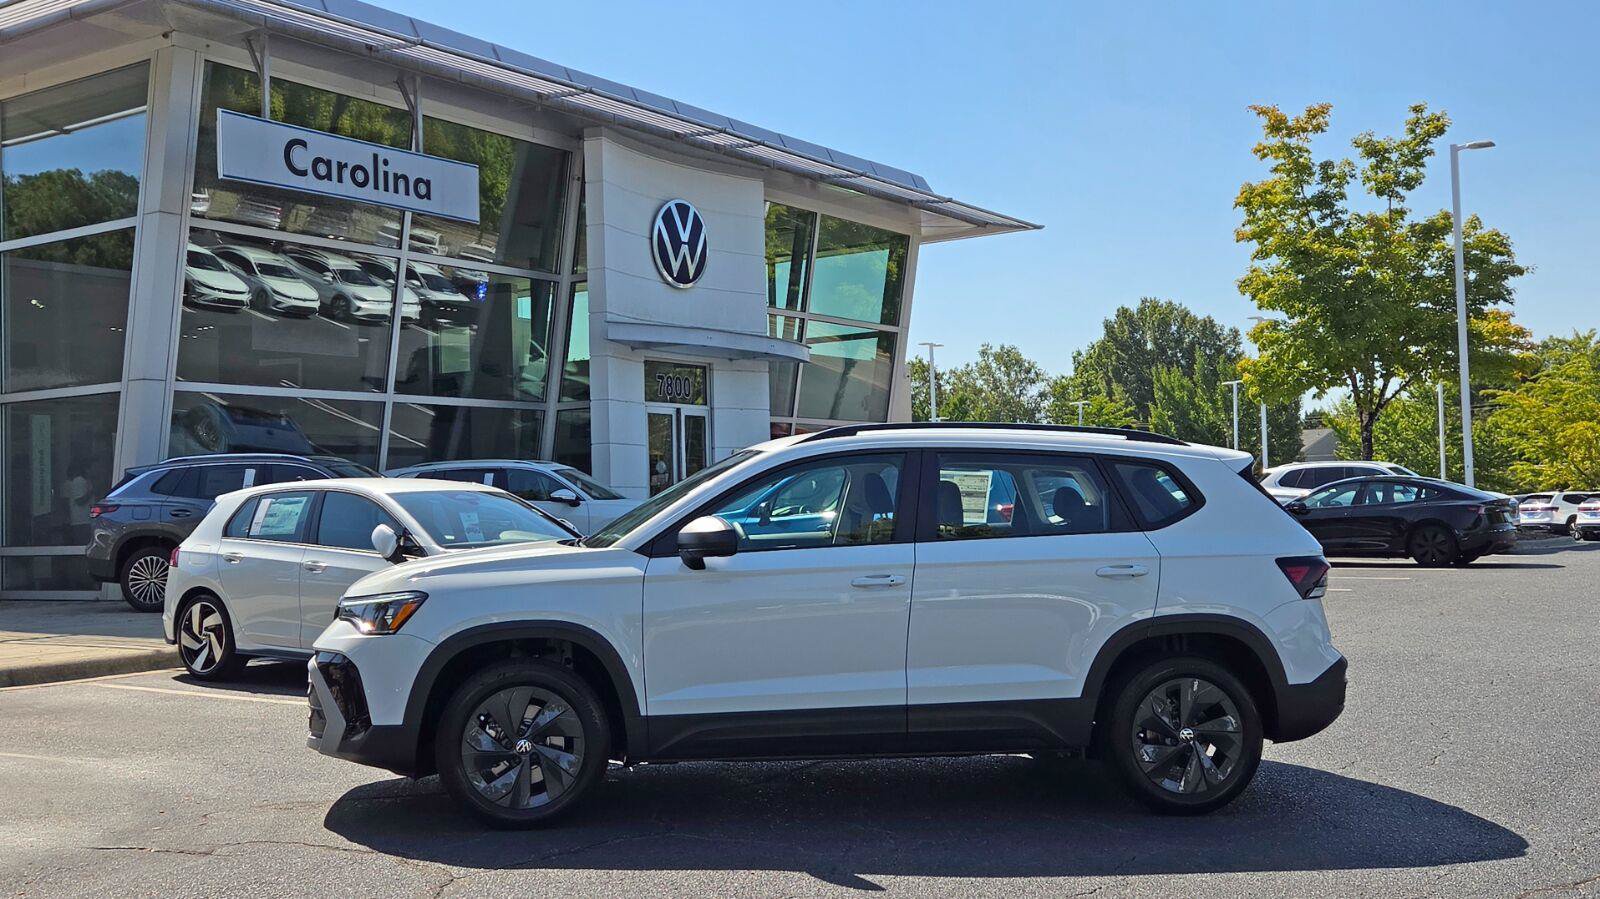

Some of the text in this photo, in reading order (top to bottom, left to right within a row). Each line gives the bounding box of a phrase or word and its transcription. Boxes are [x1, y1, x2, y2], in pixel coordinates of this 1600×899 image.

[283, 138, 431, 200] Carolina
[652, 199, 708, 288] VW
[655, 373, 692, 399] 7800
